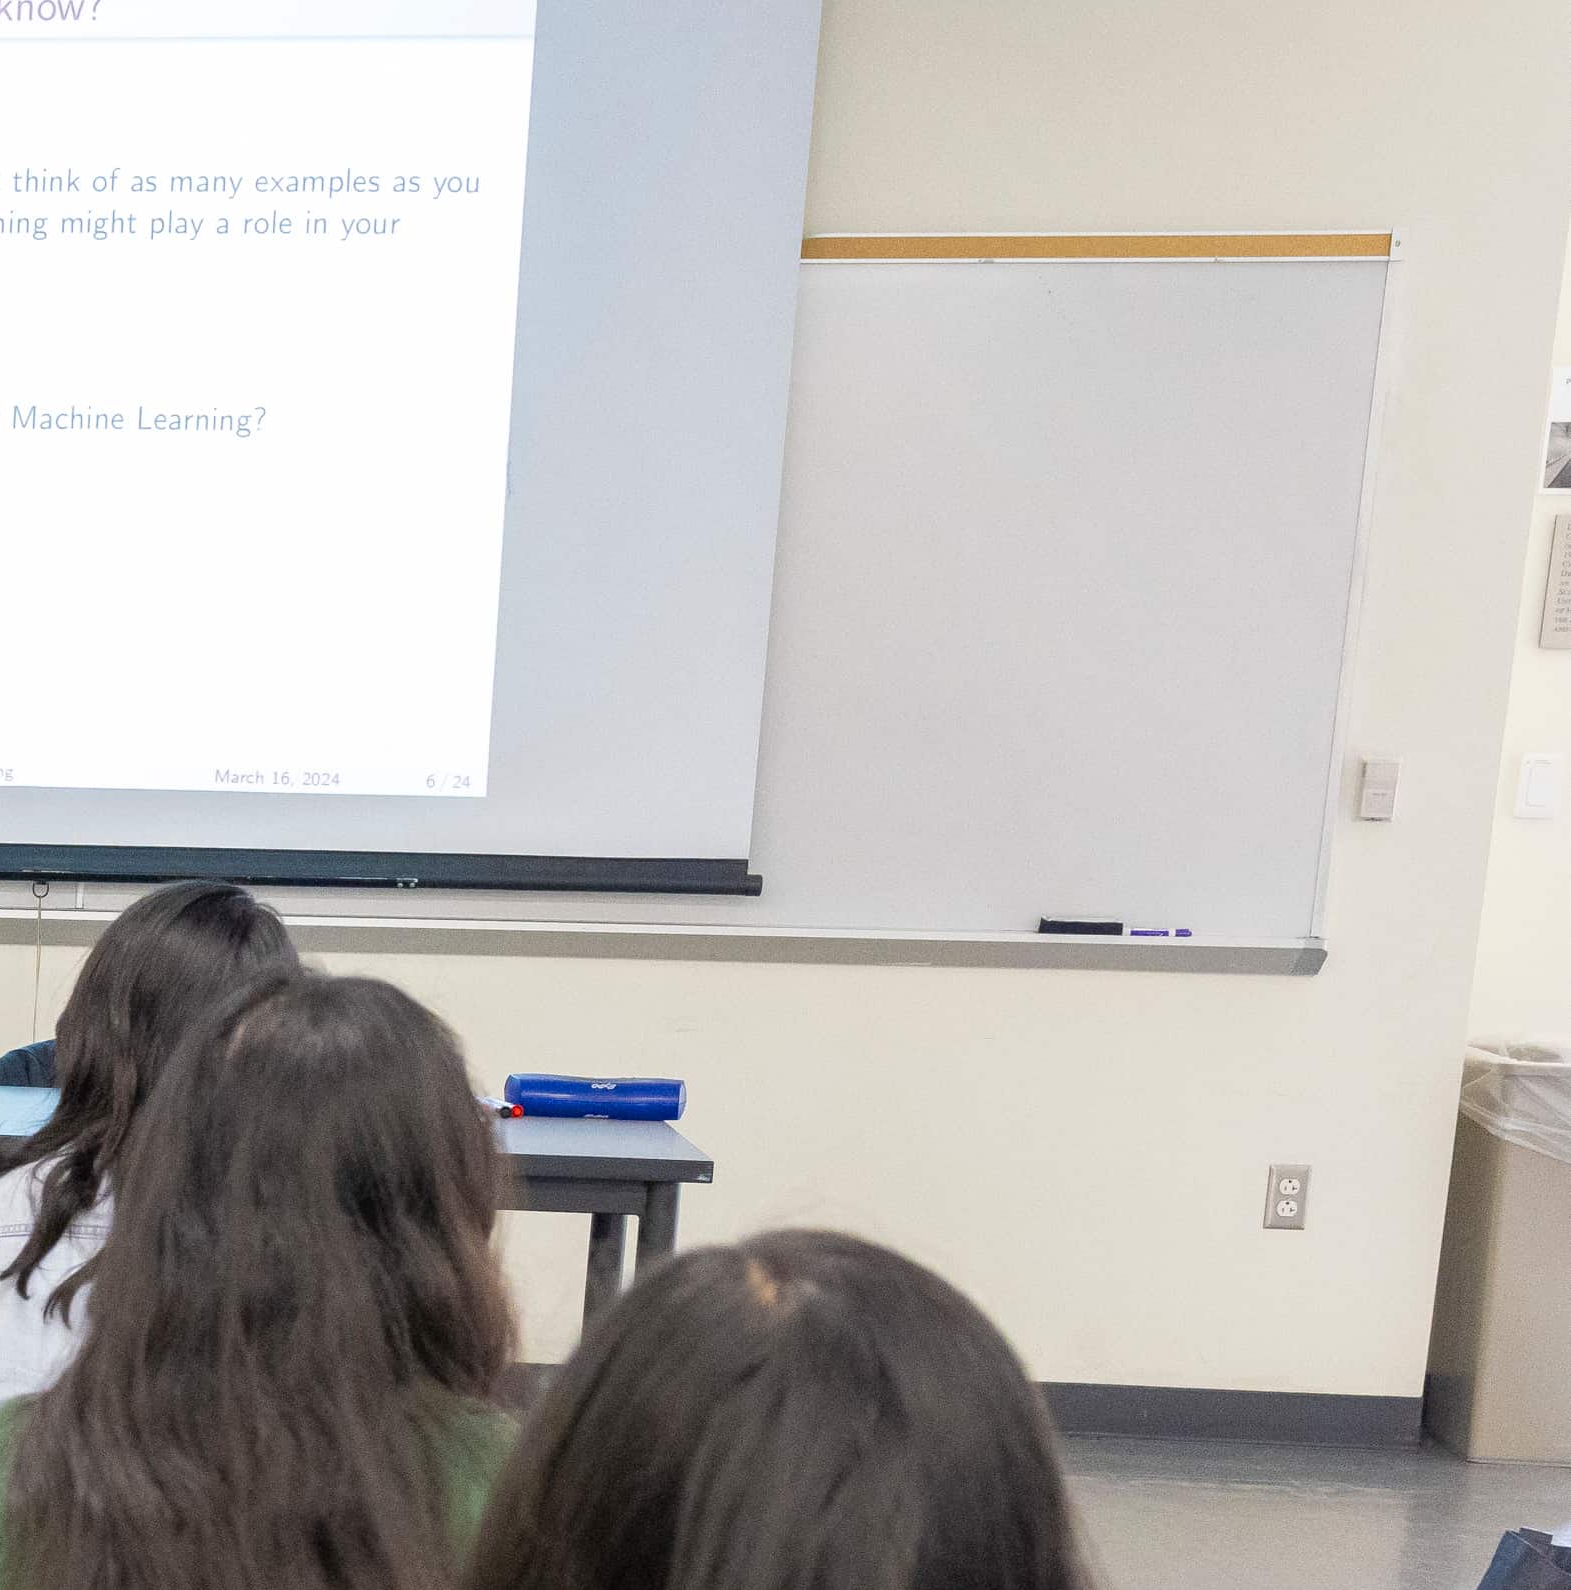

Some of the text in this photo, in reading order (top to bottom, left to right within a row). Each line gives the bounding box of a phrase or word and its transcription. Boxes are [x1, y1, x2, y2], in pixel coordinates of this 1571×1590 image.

[11, 167, 81, 193] think
[91, 167, 122, 193] of
[130, 175, 158, 193] as
[170, 175, 244, 200] many
[254, 167, 381, 200] examples
[392, 175, 422, 193] as
[432, 175, 480, 200] you
[60, 208, 137, 241] might
[149, 208, 205, 241] play
[216, 217, 230, 235] a
[243, 209, 293, 235] role
[305, 209, 327, 235] in
[340, 217, 401, 242] your
[10, 404, 125, 431] Machine
[137, 405, 267, 439] Learning?
[214, 768, 340, 787] March 16, 2024
[452, 775, 471, 790] 24
